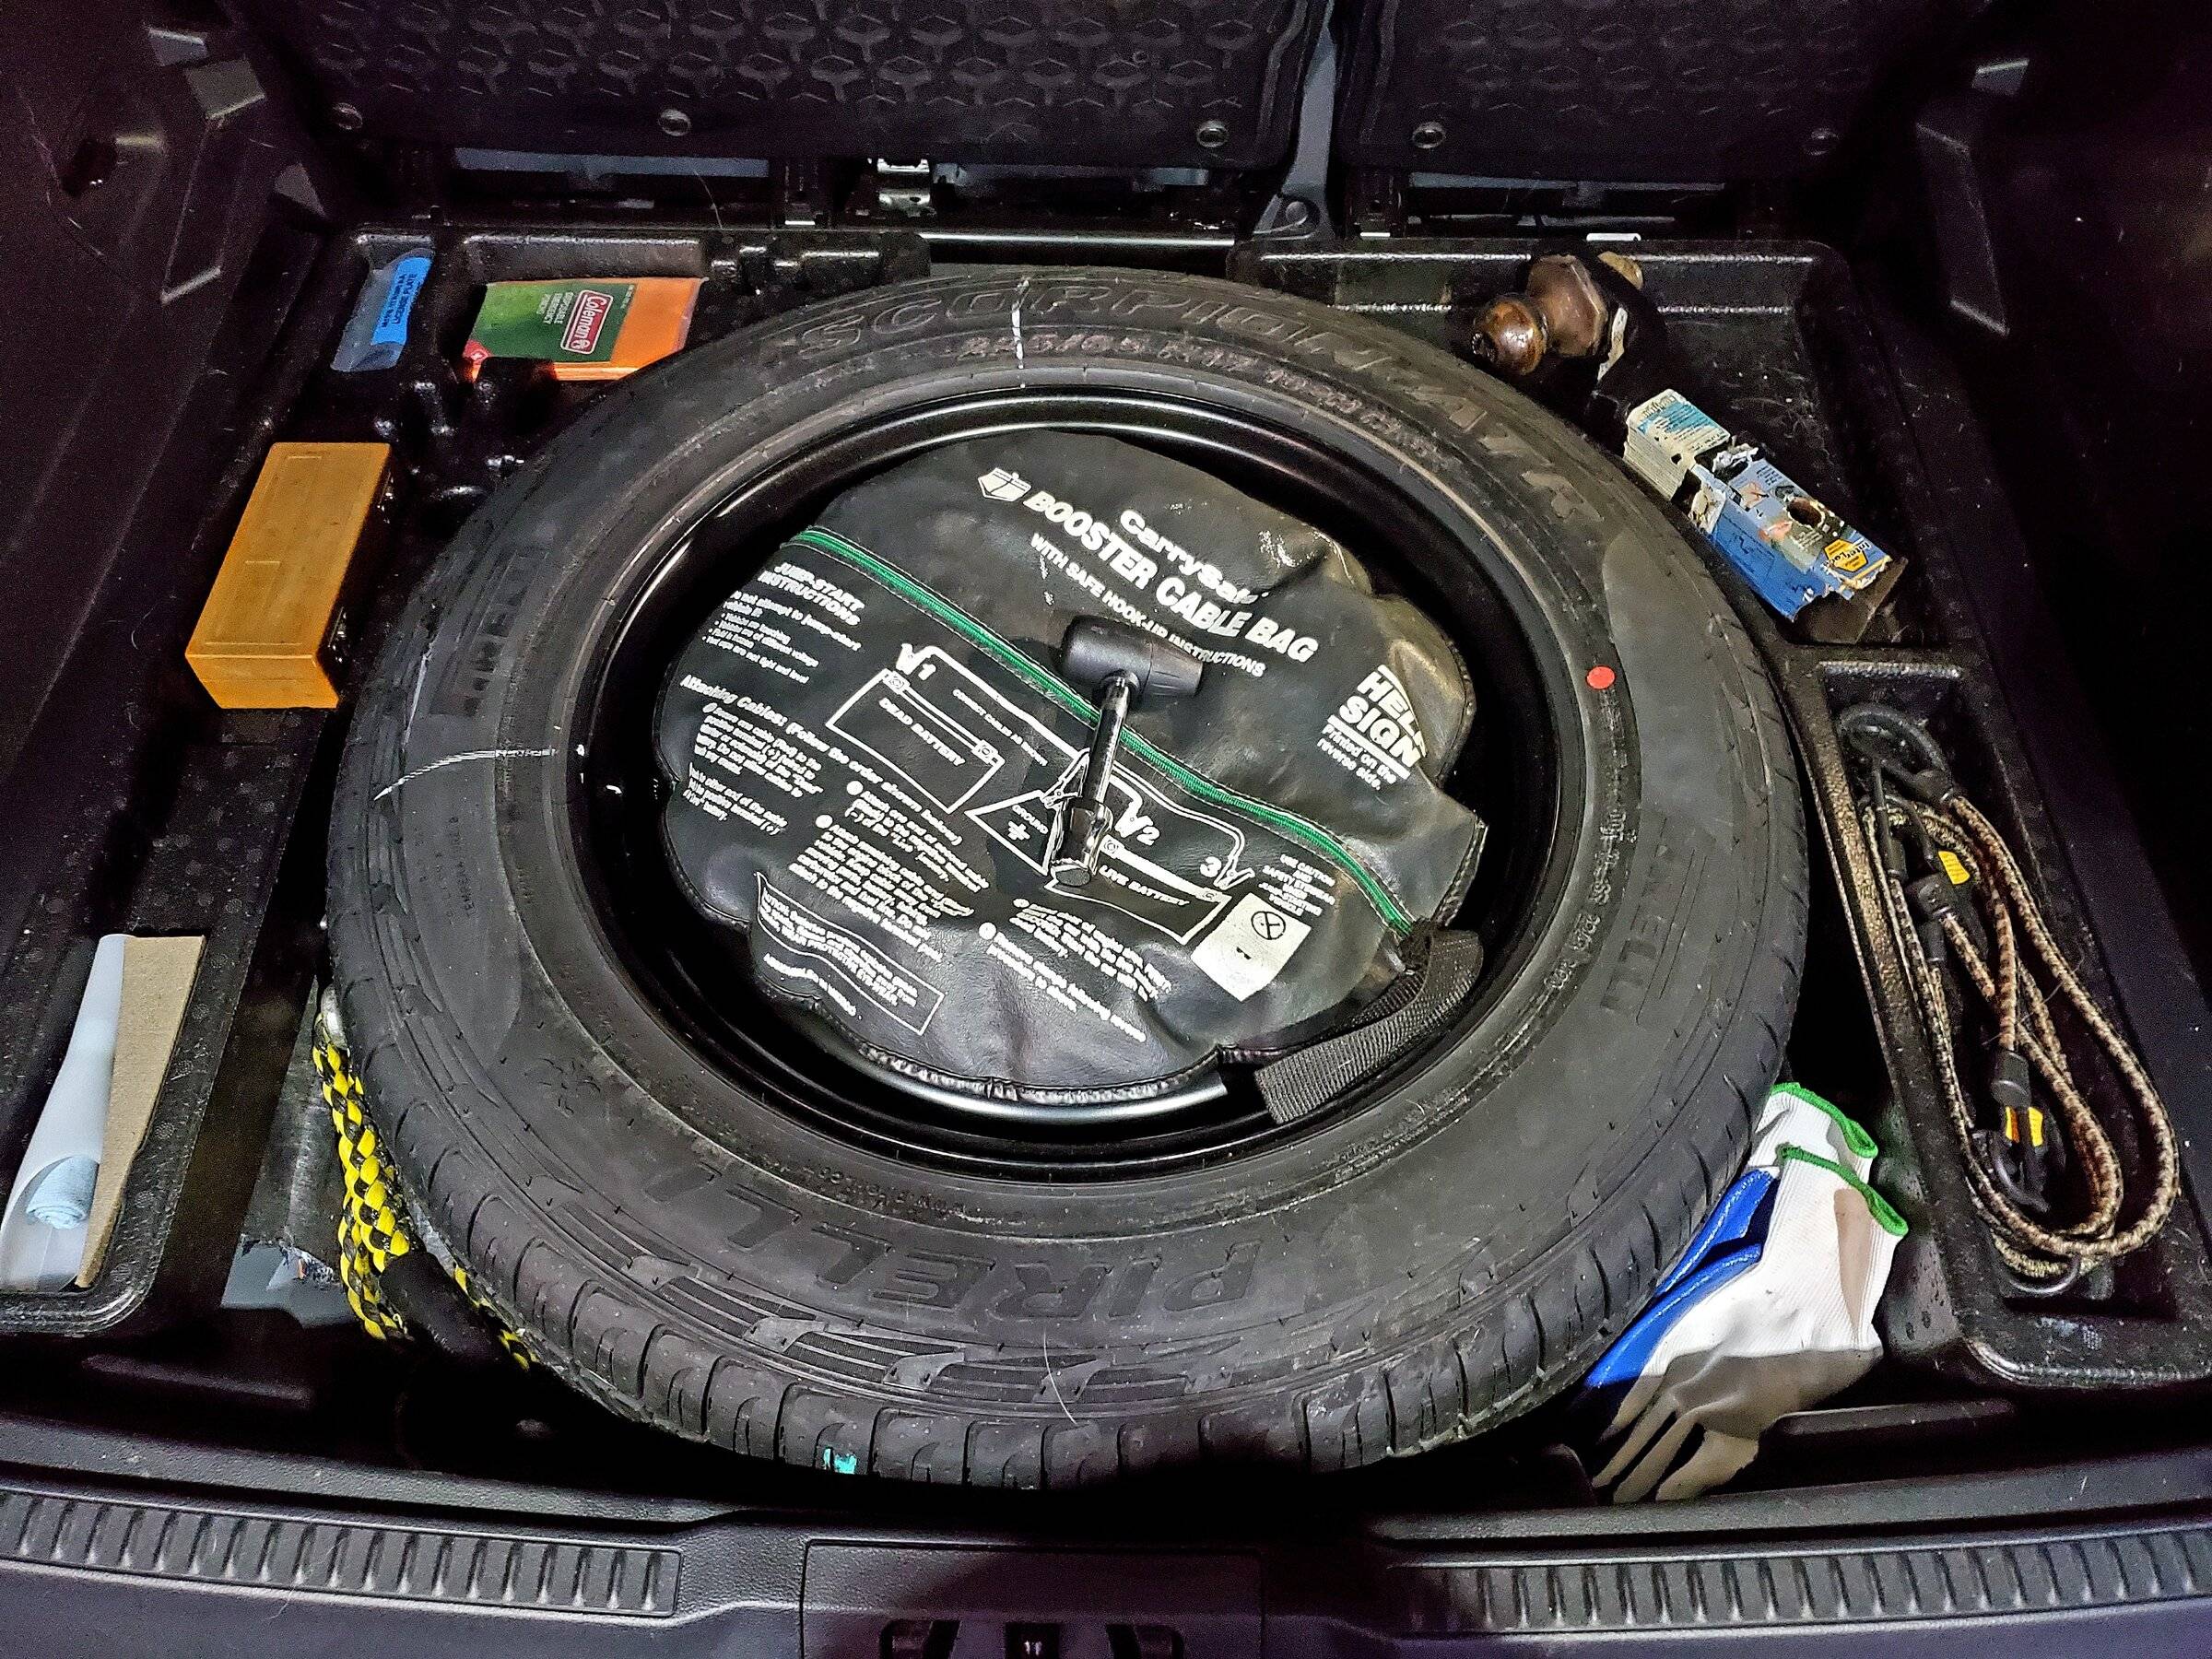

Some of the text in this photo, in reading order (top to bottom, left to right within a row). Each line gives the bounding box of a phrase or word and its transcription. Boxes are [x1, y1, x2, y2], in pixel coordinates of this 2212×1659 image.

[574, 293, 606, 340] Coleman
[800, 284, 1394, 372] SCORPION
[1026, 533, 1069, 569] WITH
[1065, 562, 1105, 598] SAFE
[1822, 541, 1869, 567] InterLoc
[758, 571, 860, 625] INSTRUCTIONS
[774, 562, 865, 611] JUMP-START
[1023, 491, 1318, 662] BOOSTER CABLE BAG
[791, 610, 803, 620] to
[918, 664, 935, 680] 1
[879, 698, 965, 766] DEAD BATTERY
[1339, 696, 1420, 767] SIGN
[680, 675, 962, 845] Attaching Cables: (Follow the order shown below)
[795, 752, 806, 762] to
[806, 758, 821, 771] the
[1317, 738, 1357, 771] reverse
[1322, 724, 1396, 784] Printed on the
[829, 825, 859, 844] Attach
[860, 791, 890, 812] Attach
[889, 810, 907, 823] one
[907, 821, 926, 836] end
[924, 834, 937, 843] of
[883, 818, 894, 828] to
[893, 824, 910, 838] the
[1012, 805, 1048, 834] GROUND
[1137, 826, 1159, 845] 2
[821, 832, 833, 841] to
[832, 838, 849, 850] the
[901, 881, 915, 890] of
[1201, 856, 1221, 877] 3
[1280, 854, 1335, 887] USE CAUTION
[1292, 870, 1312, 887] AND
[816, 879, 828, 889] to
[827, 886, 843, 900] the
[841, 881, 861, 895] and
[896, 914, 912, 929] Do
[1099, 865, 1189, 905] LIVE BATTERY
[642, 1162, 1264, 1320] PIRELLI
